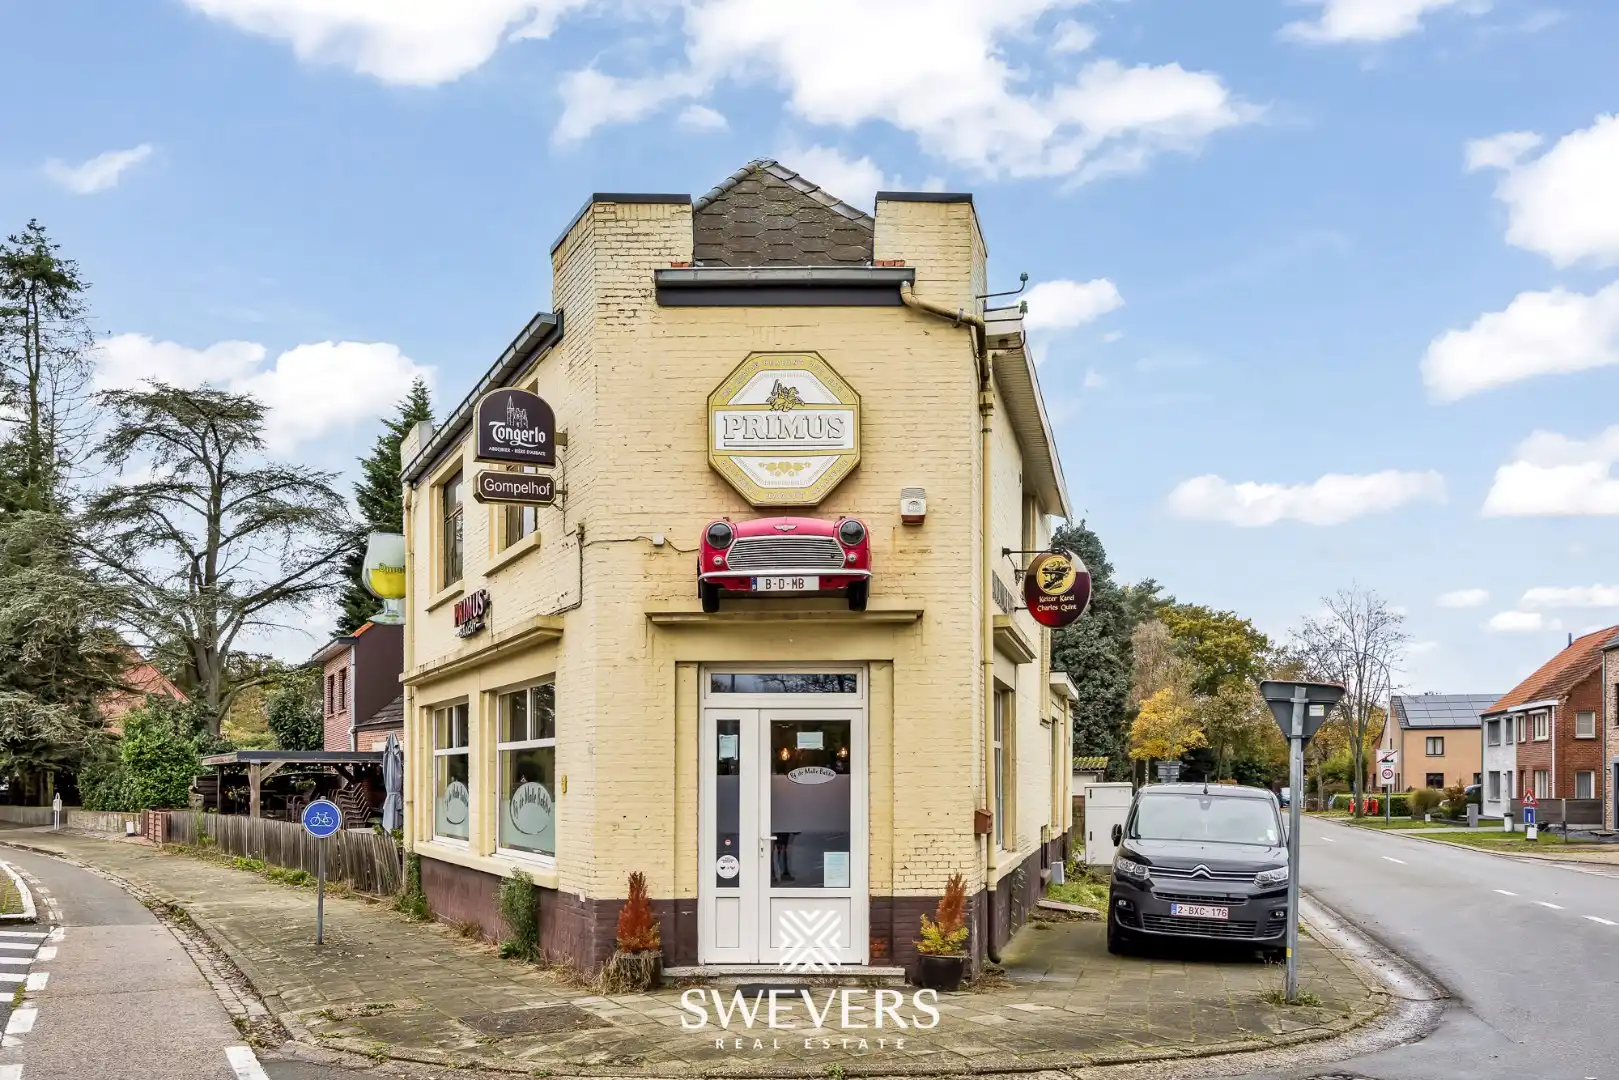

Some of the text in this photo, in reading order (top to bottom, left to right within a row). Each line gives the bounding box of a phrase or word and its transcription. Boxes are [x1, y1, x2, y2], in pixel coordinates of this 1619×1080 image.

[489, 421, 546, 448] Tongerlo
[724, 415, 845, 439] PRIMUS
[484, 478, 551, 496] Gompelhof
[454, 588, 486, 628] PRIMUS
[1036, 604, 1058, 612] Charles
[1178, 905, 1227, 917] 2-BXC-176
